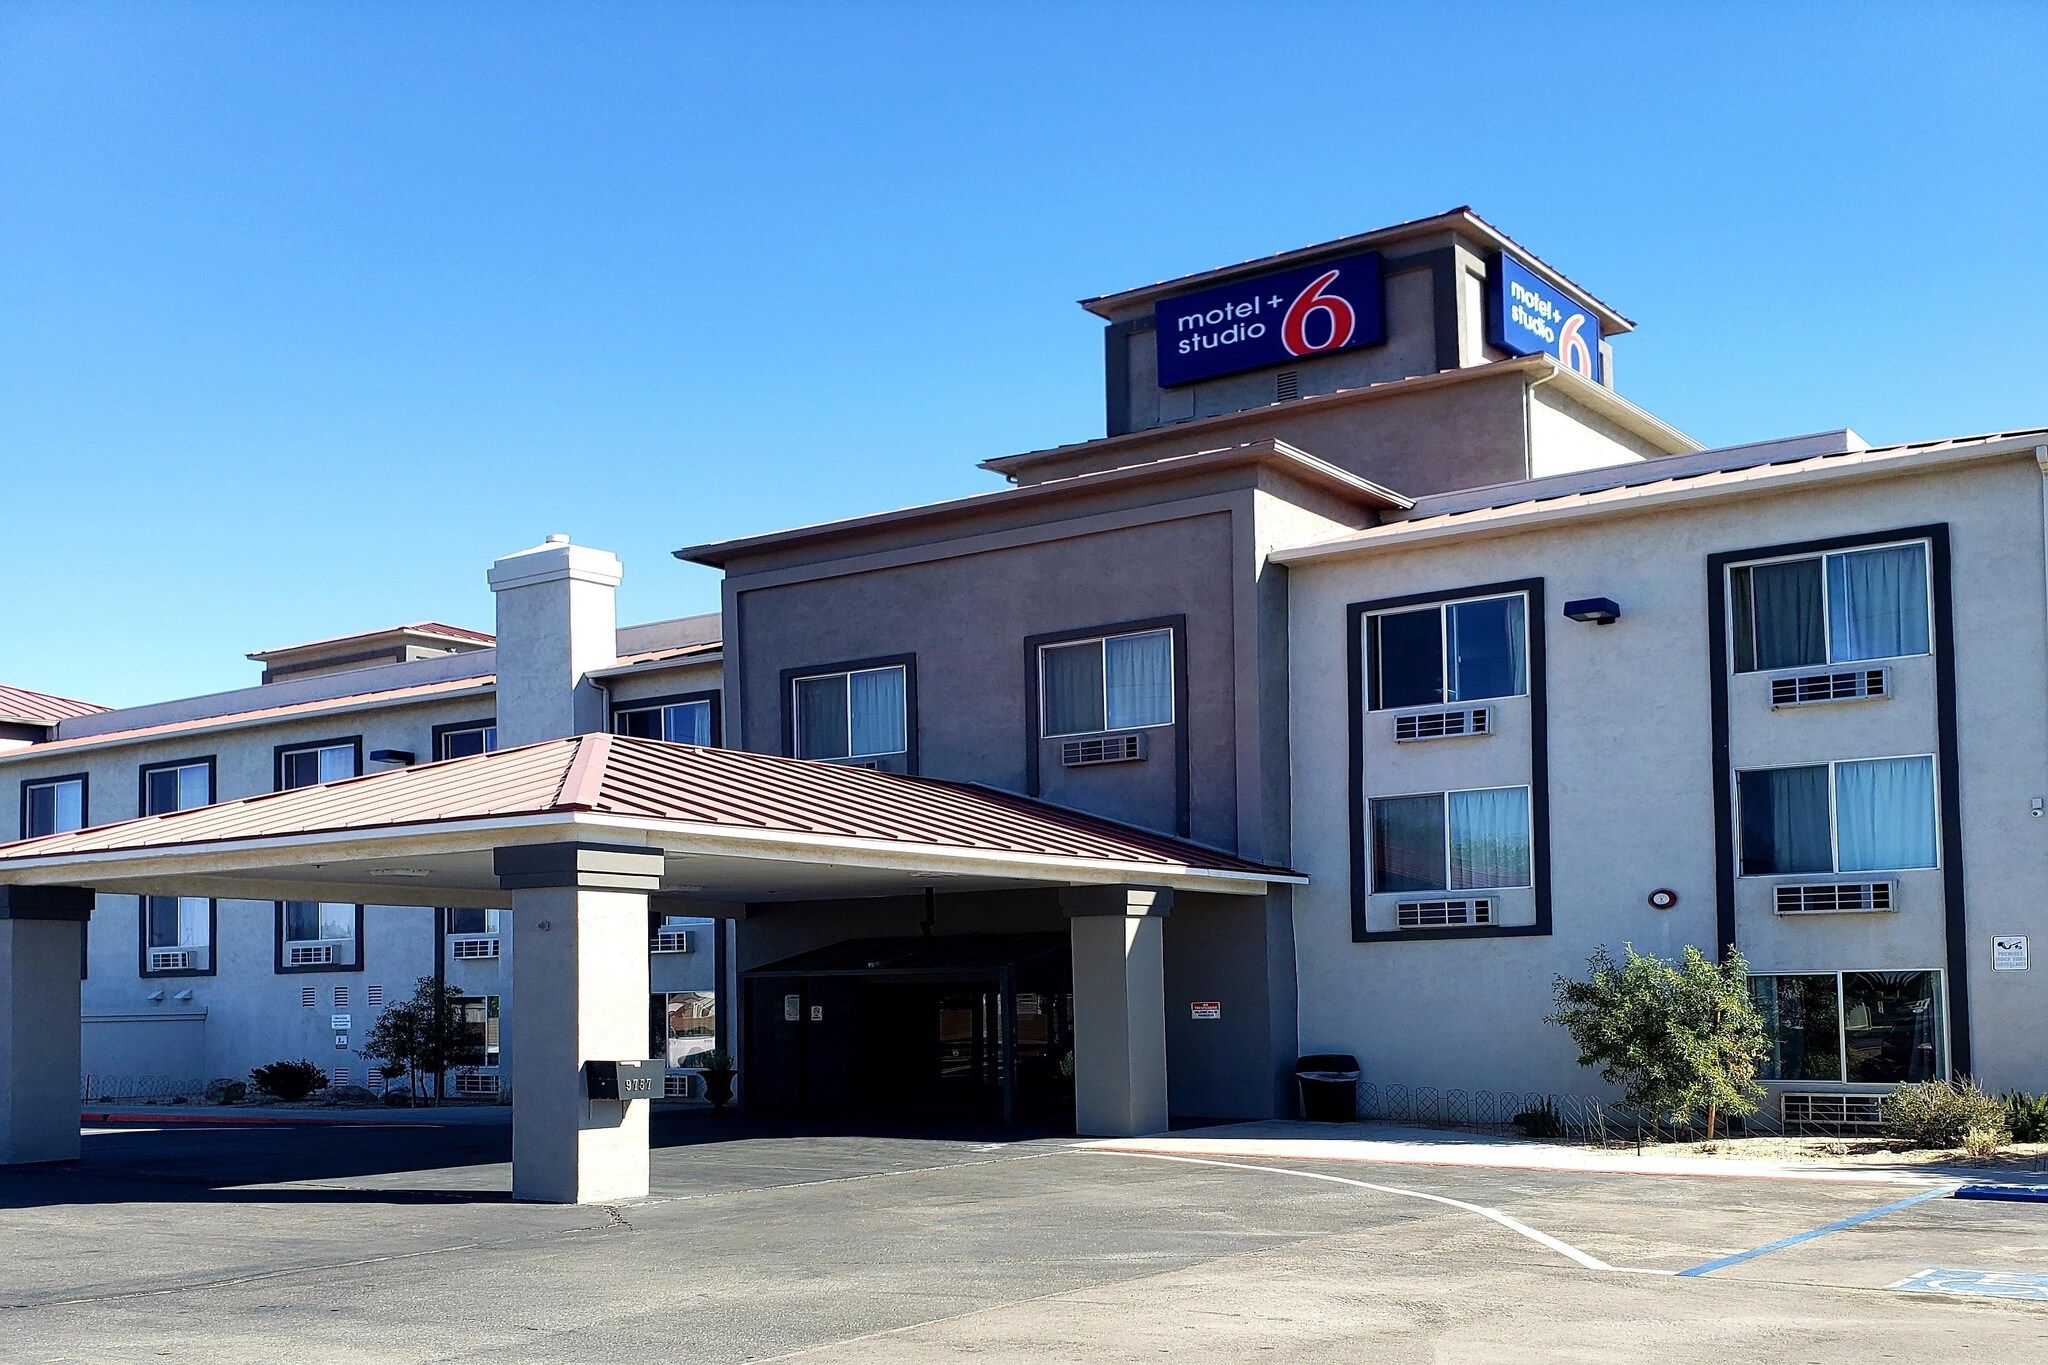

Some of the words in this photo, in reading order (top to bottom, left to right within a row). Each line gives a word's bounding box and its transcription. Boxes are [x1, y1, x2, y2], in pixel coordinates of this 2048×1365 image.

[1178, 296, 1260, 332] motel
[1281, 269, 1355, 356] 6
[1510, 281, 1552, 320] motel
[1178, 323, 1266, 354] studio
[1511, 305, 1555, 343] studio
[1558, 313, 1592, 380] 6
[625, 1078, 652, 1091] 9757
